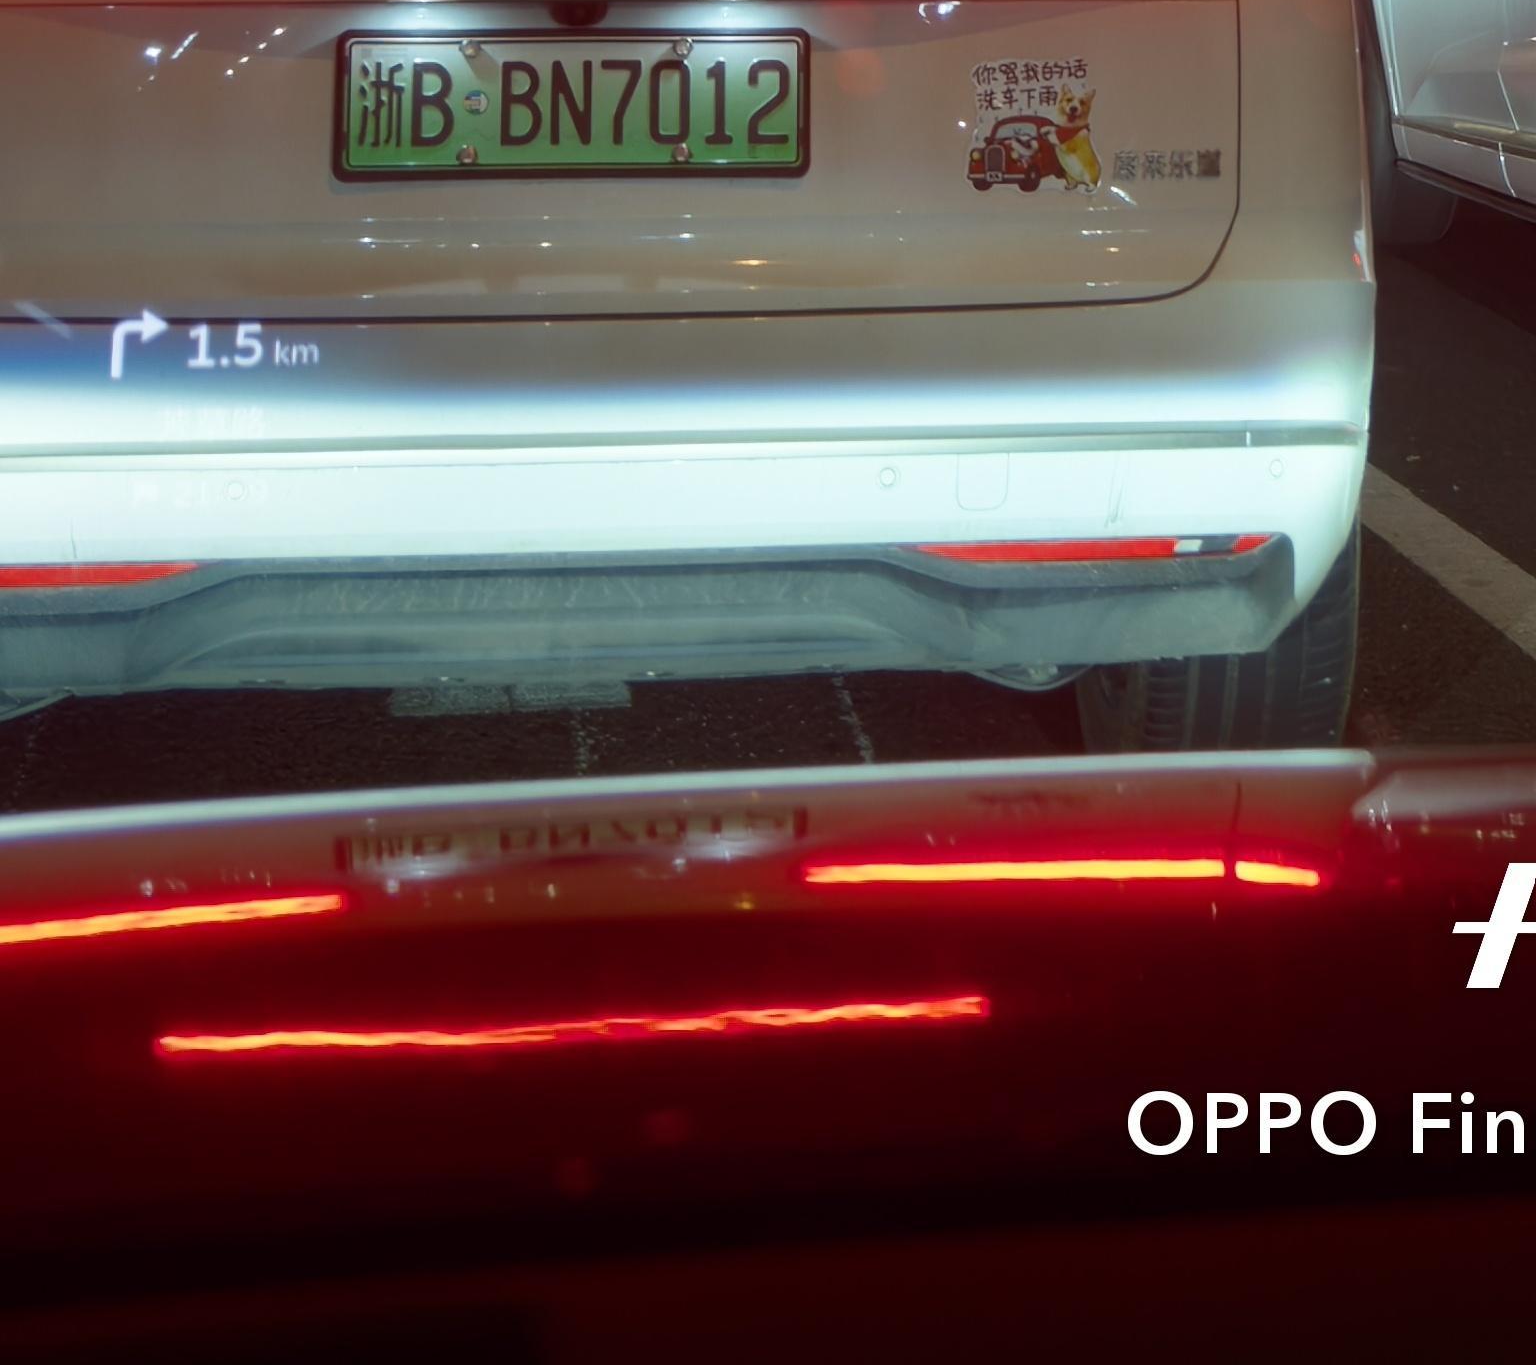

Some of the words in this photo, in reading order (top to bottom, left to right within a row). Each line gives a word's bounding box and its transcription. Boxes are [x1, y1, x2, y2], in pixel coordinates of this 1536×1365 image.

[357, 61, 455, 149] 浙B
[500, 59, 790, 147] BN7012
[976, 85, 1059, 111] 洗车下雨
[187, 322, 264, 369] 1.5
[273, 339, 320, 366] km
